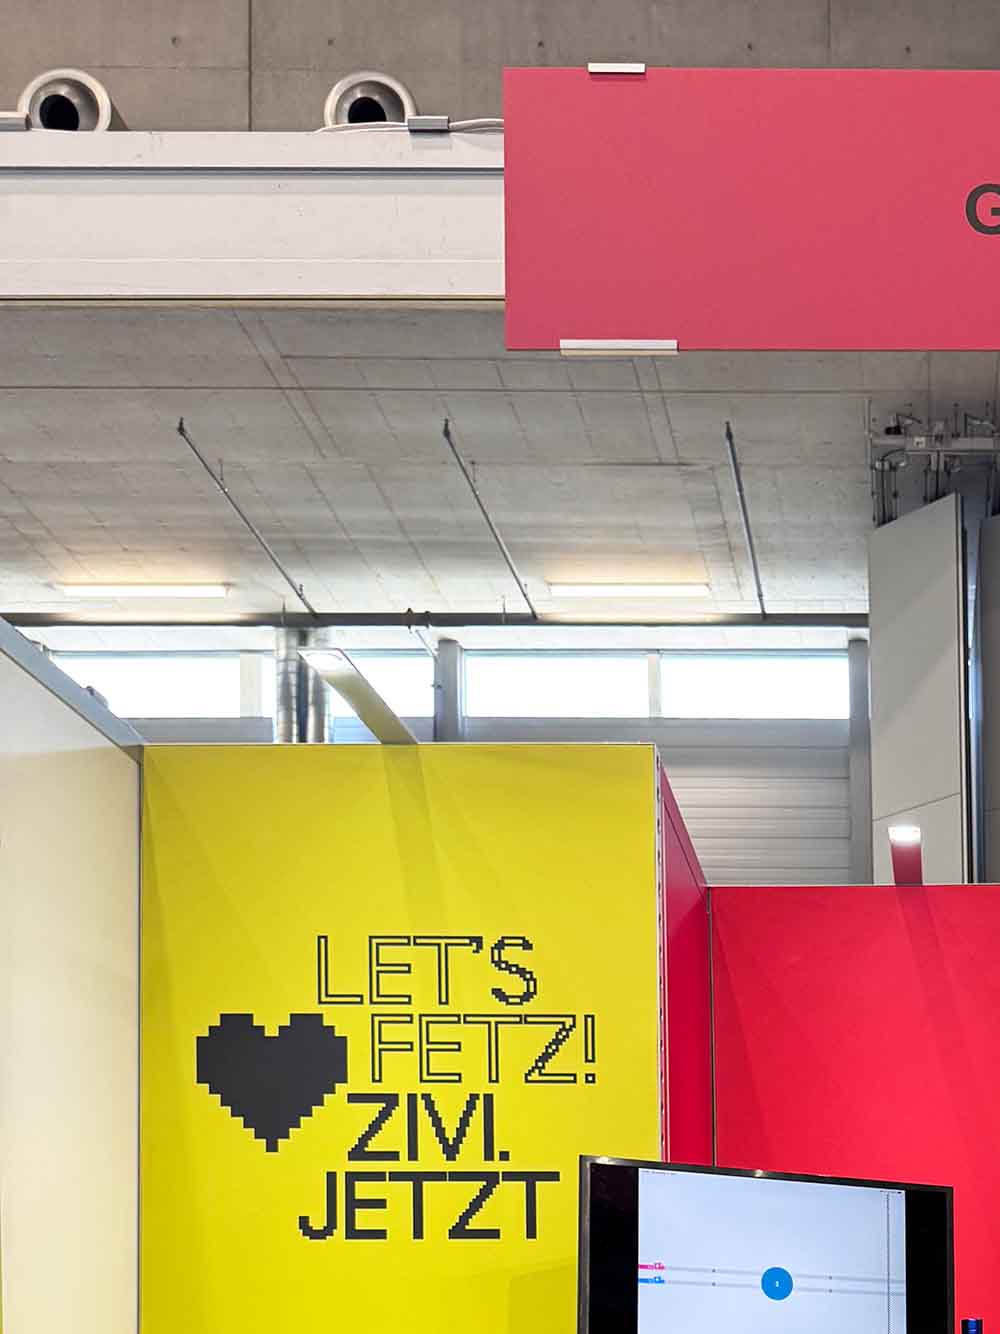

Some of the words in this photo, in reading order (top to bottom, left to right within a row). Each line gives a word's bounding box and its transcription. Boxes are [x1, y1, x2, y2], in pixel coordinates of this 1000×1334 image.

[317, 935, 538, 1006] LET'S
[371, 1014, 597, 1084] FETZ!
[346, 1093, 511, 1162] ZIVI.
[298, 1171, 561, 1241] JETZT
